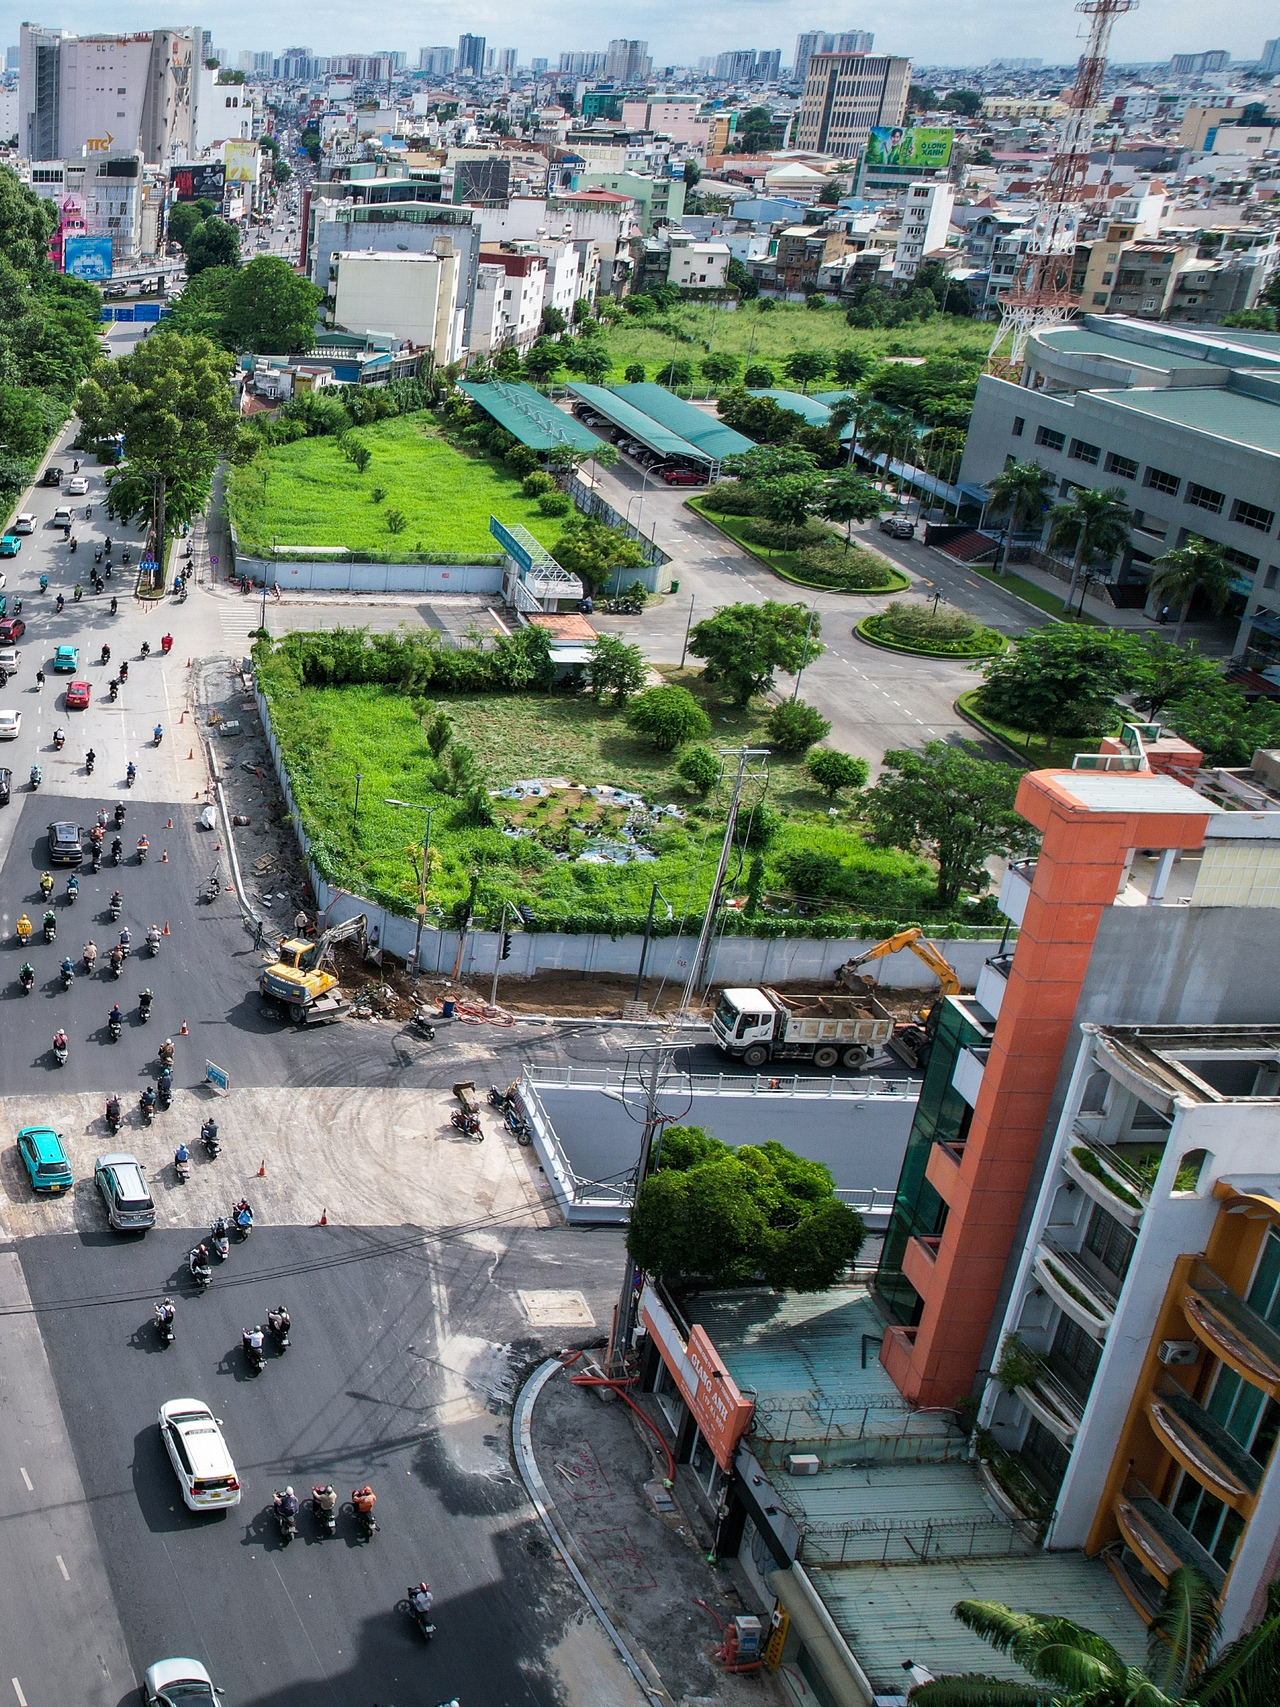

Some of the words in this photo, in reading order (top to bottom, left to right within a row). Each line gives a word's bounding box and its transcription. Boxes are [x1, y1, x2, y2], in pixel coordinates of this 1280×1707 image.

[87, 138, 109, 150] TTC
[272, 986, 286, 994] VOLVO
[712, 1392, 728, 1422] ANH
